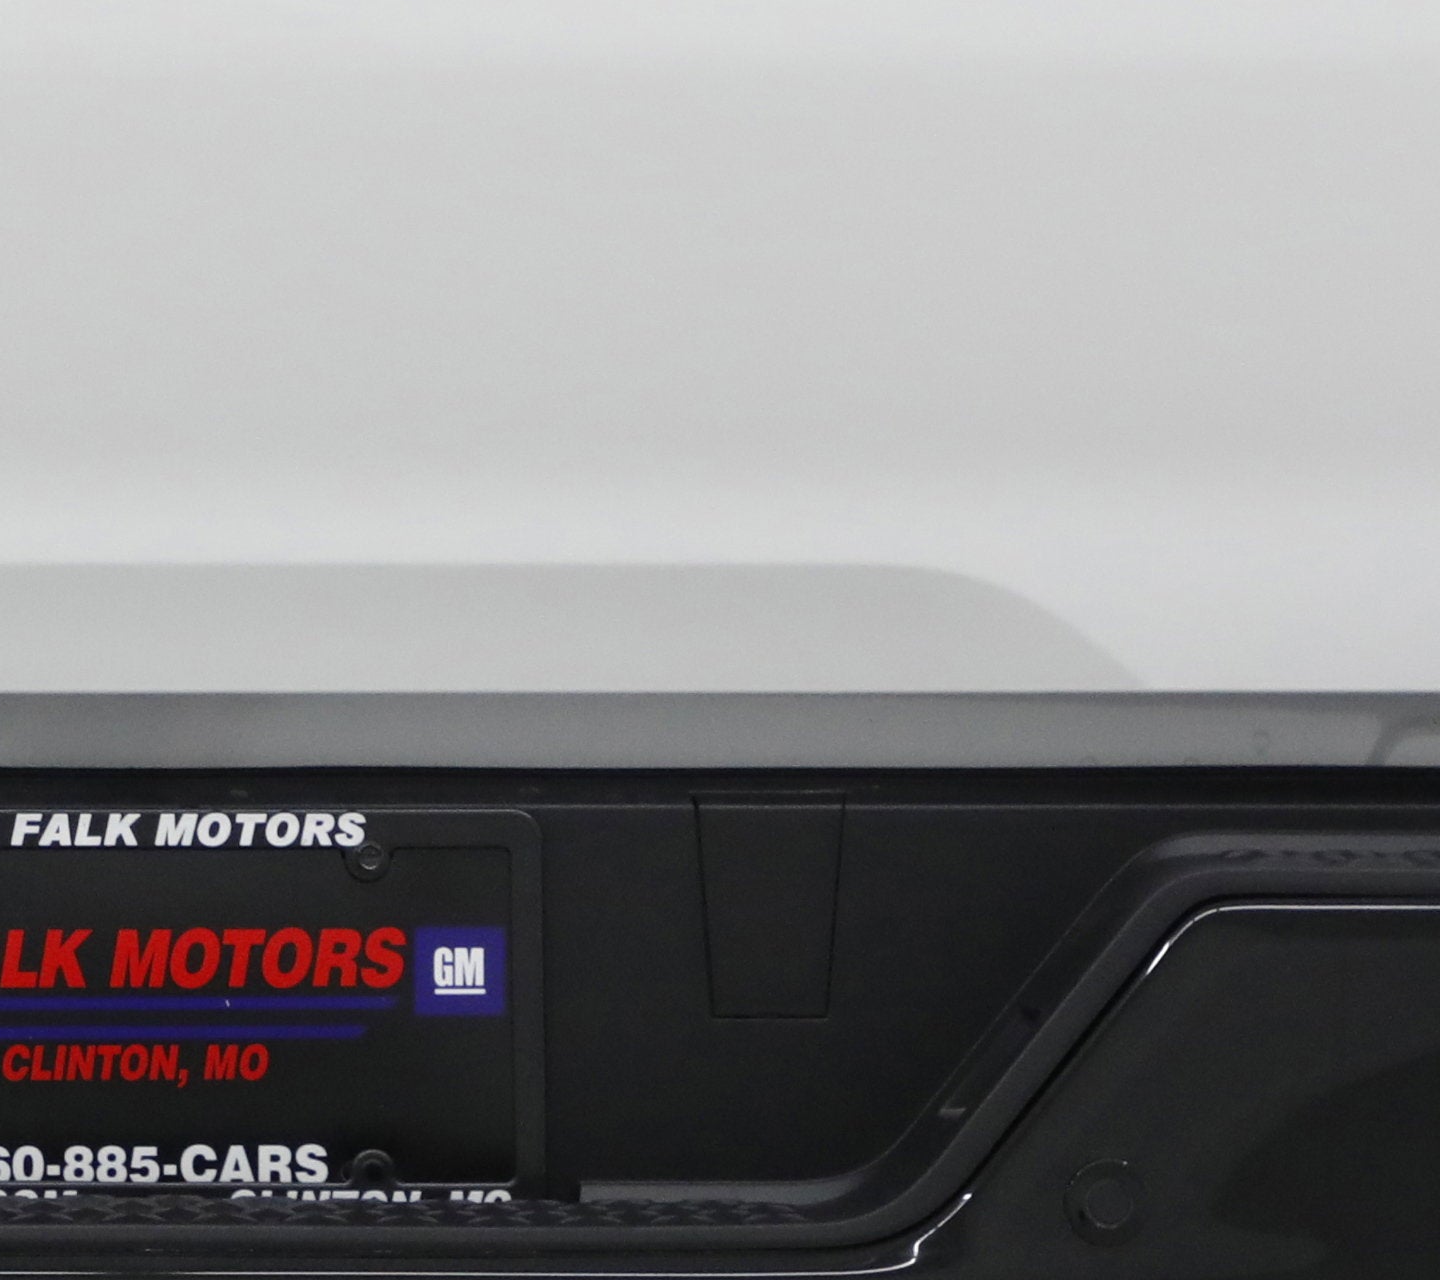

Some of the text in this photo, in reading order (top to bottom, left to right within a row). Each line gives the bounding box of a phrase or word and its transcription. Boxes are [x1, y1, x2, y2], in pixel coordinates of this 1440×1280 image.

[10, 811, 142, 848] FALK
[153, 810, 368, 849] MOTORS
[108, 925, 408, 991] MOTORS
[432, 945, 486, 988] GM
[1, 1042, 270, 1089] CLINTON, MO
